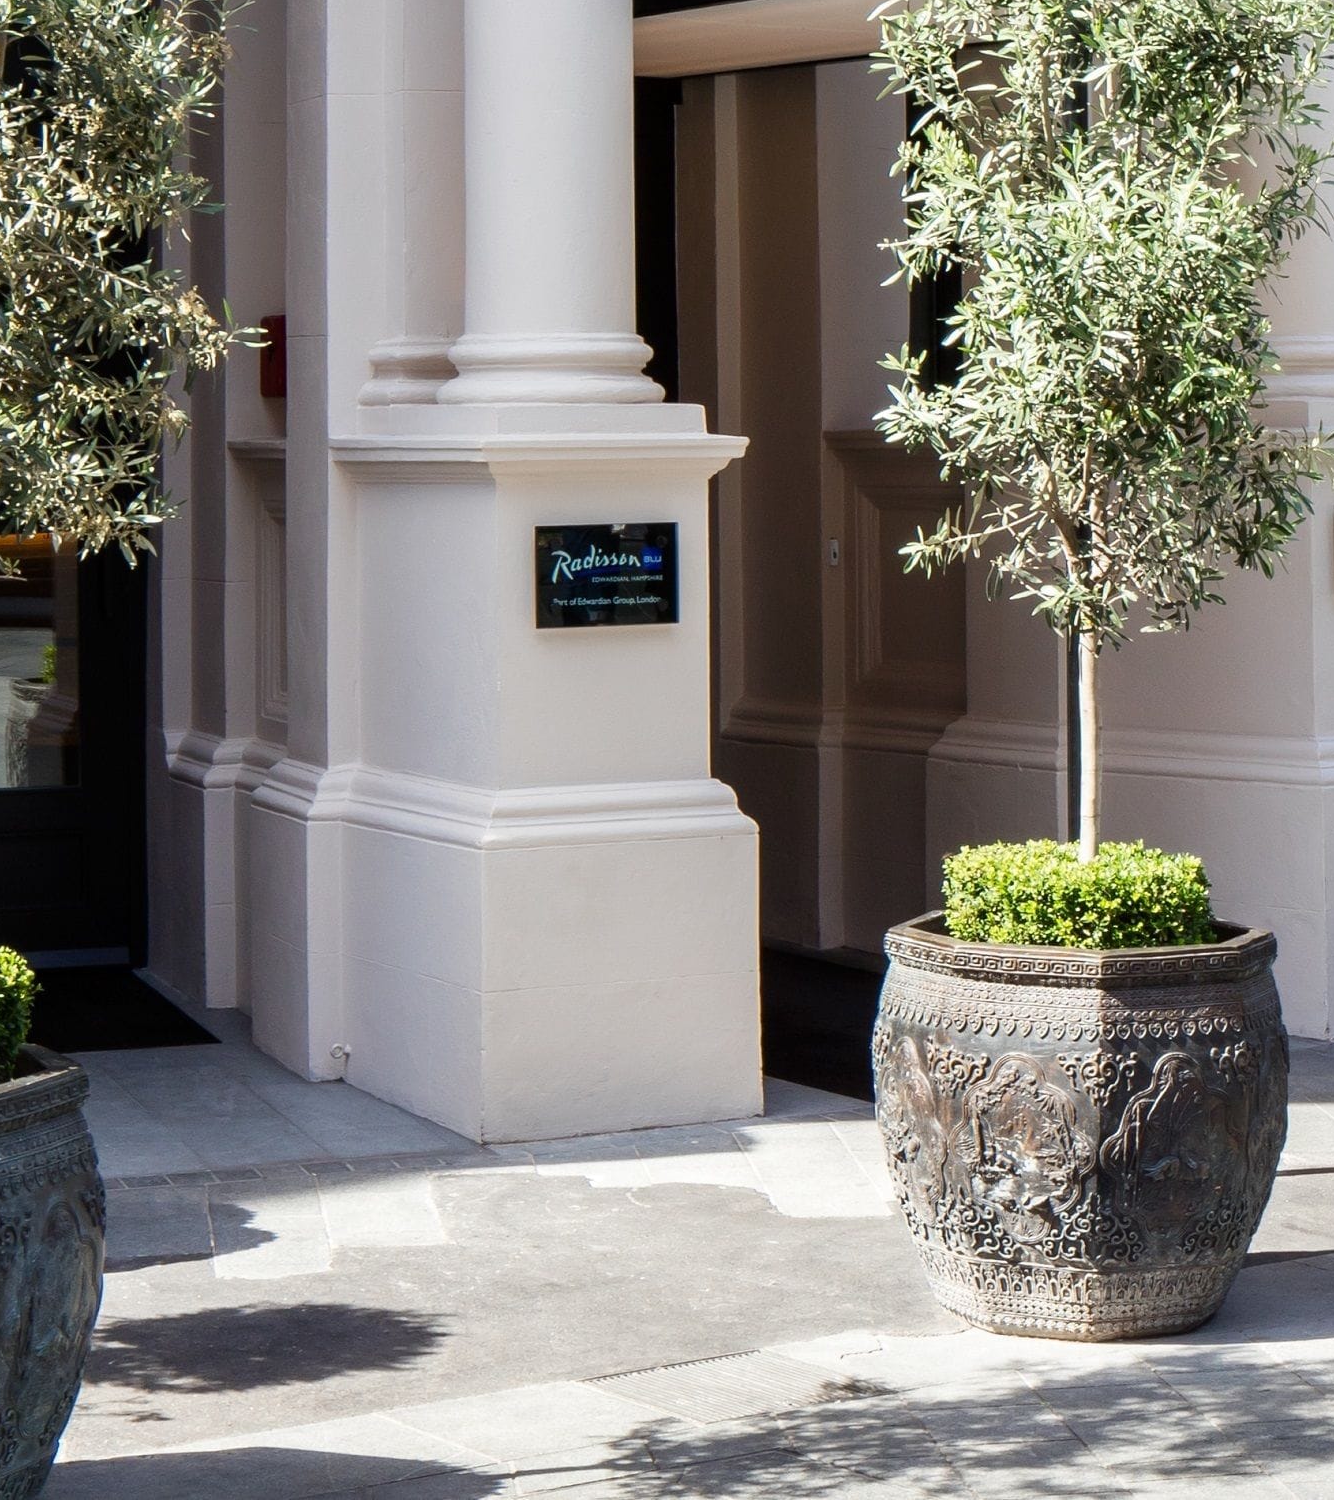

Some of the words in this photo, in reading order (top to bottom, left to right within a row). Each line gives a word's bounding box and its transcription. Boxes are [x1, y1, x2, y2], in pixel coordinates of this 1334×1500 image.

[551, 544, 641, 584] Radisson
[569, 597, 577, 605] of
[577, 597, 611, 606] Edwardian
